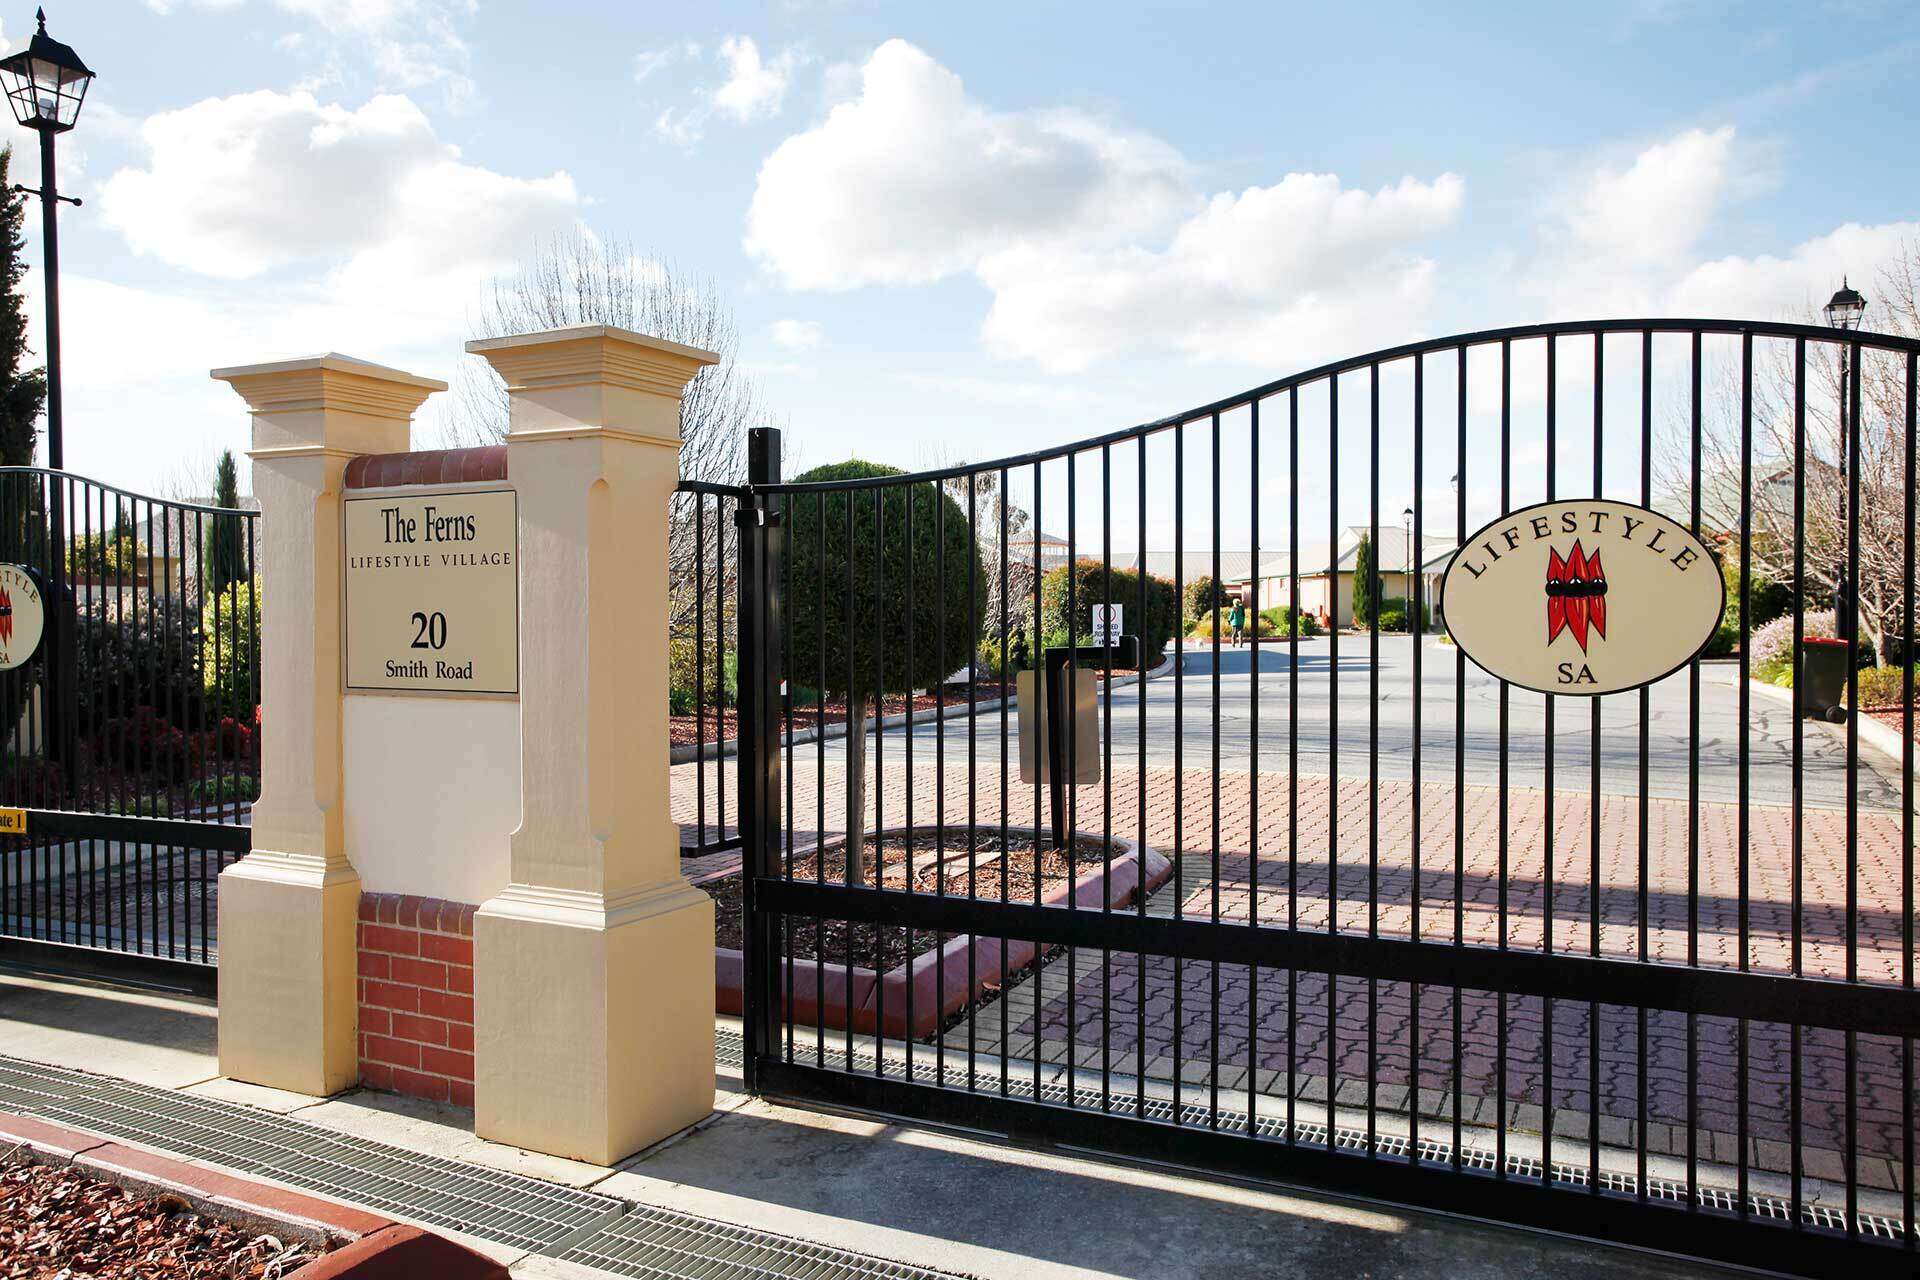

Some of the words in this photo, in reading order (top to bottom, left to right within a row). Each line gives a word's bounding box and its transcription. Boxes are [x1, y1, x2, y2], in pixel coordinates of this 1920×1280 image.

[381, 507, 416, 543] The
[424, 506, 476, 541] Ferns
[1462, 511, 1699, 579] LIFESTYLE
[351, 554, 431, 568] LIFESTYLE
[442, 552, 511, 566] VILLAGE
[411, 612, 447, 649] 20
[385, 660, 428, 678] Smith
[436, 661, 473, 679] Road
[1558, 663, 1598, 684] SA
